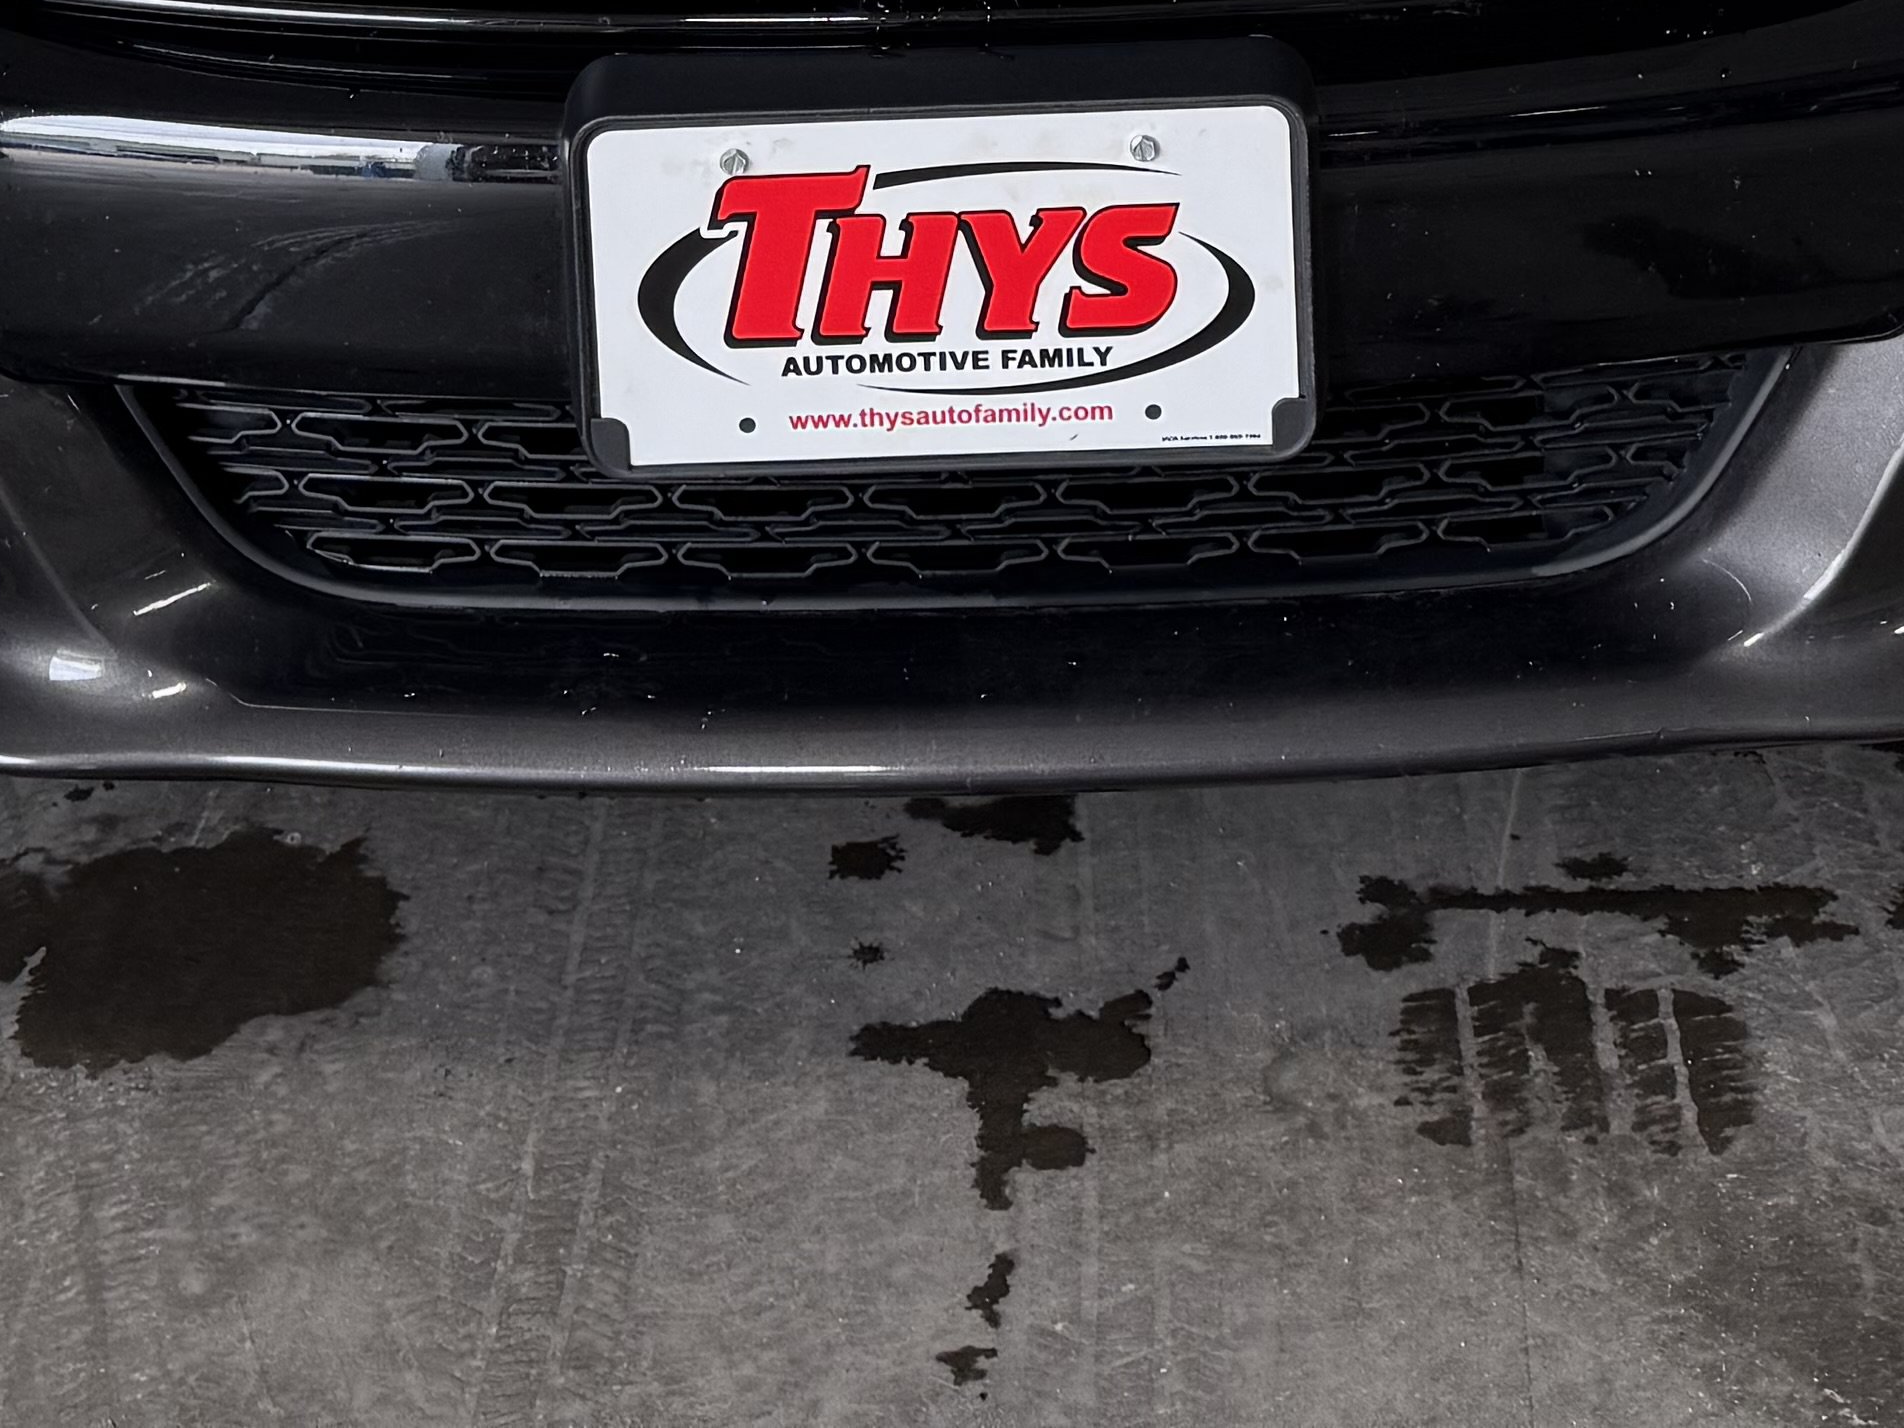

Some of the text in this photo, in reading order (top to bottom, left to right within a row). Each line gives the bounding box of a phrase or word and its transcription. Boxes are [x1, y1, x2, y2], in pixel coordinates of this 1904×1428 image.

[710, 164, 1180, 347] THYS
[781, 345, 1115, 377] AUTOMOTIVE FAMILY
[788, 402, 1114, 434] www.thysautofamily.com
